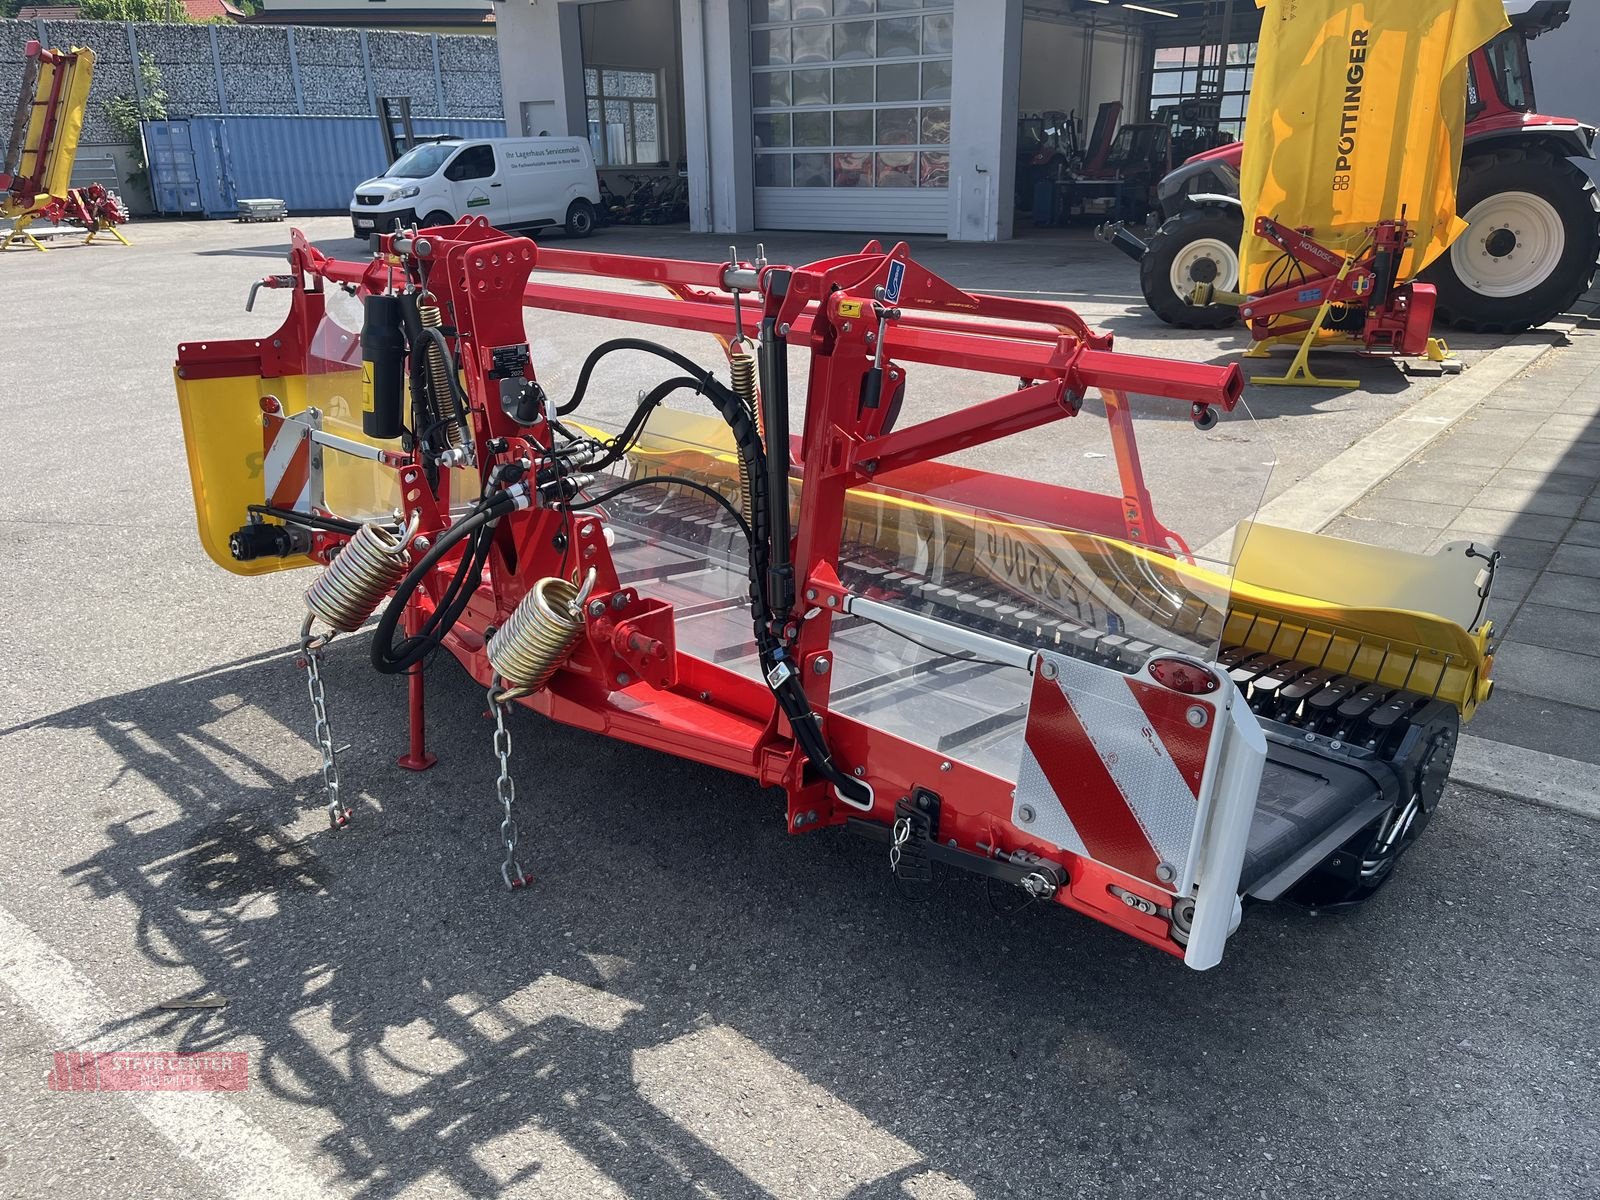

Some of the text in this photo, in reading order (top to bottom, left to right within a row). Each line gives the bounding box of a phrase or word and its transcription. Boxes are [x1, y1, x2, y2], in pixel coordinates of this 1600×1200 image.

[1335, 29, 1369, 172] PÖTTINGER
[515, 149, 545, 159] Lagerhaus
[545, 145, 580, 155] Servicemobil
[1298, 240, 1333, 263] NOVADISC
